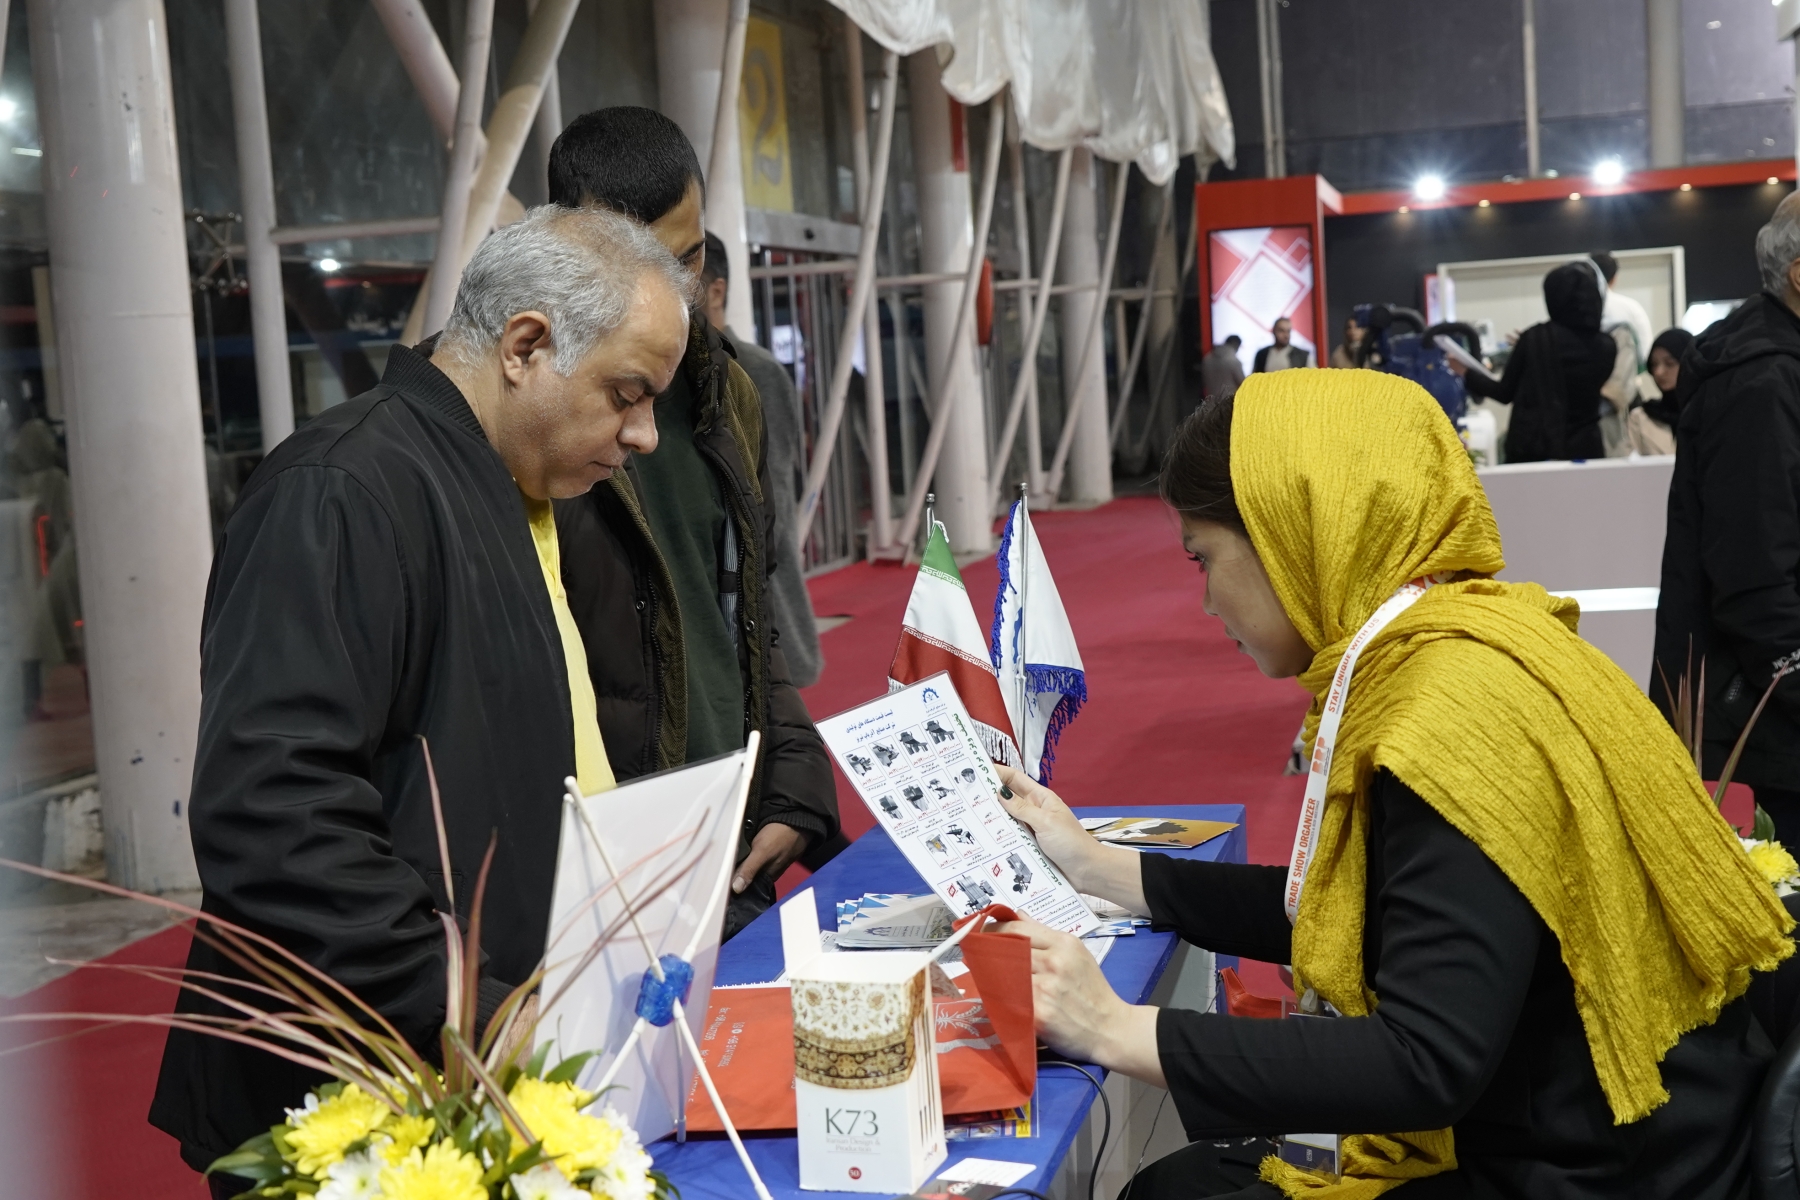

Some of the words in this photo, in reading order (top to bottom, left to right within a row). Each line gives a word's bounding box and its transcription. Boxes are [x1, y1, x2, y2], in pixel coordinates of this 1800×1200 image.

[1328, 689, 1340, 712] STAY
[1336, 653, 1352, 687] UNIQUE
[1350, 629, 1369, 651] WITH
[1368, 618, 1379, 629] US
[1299, 798, 1317, 848] ORGANIZER
[1293, 849, 1306, 878] SHOW
[1288, 880, 1300, 908] TRADE
[825, 1107, 879, 1136] K73
